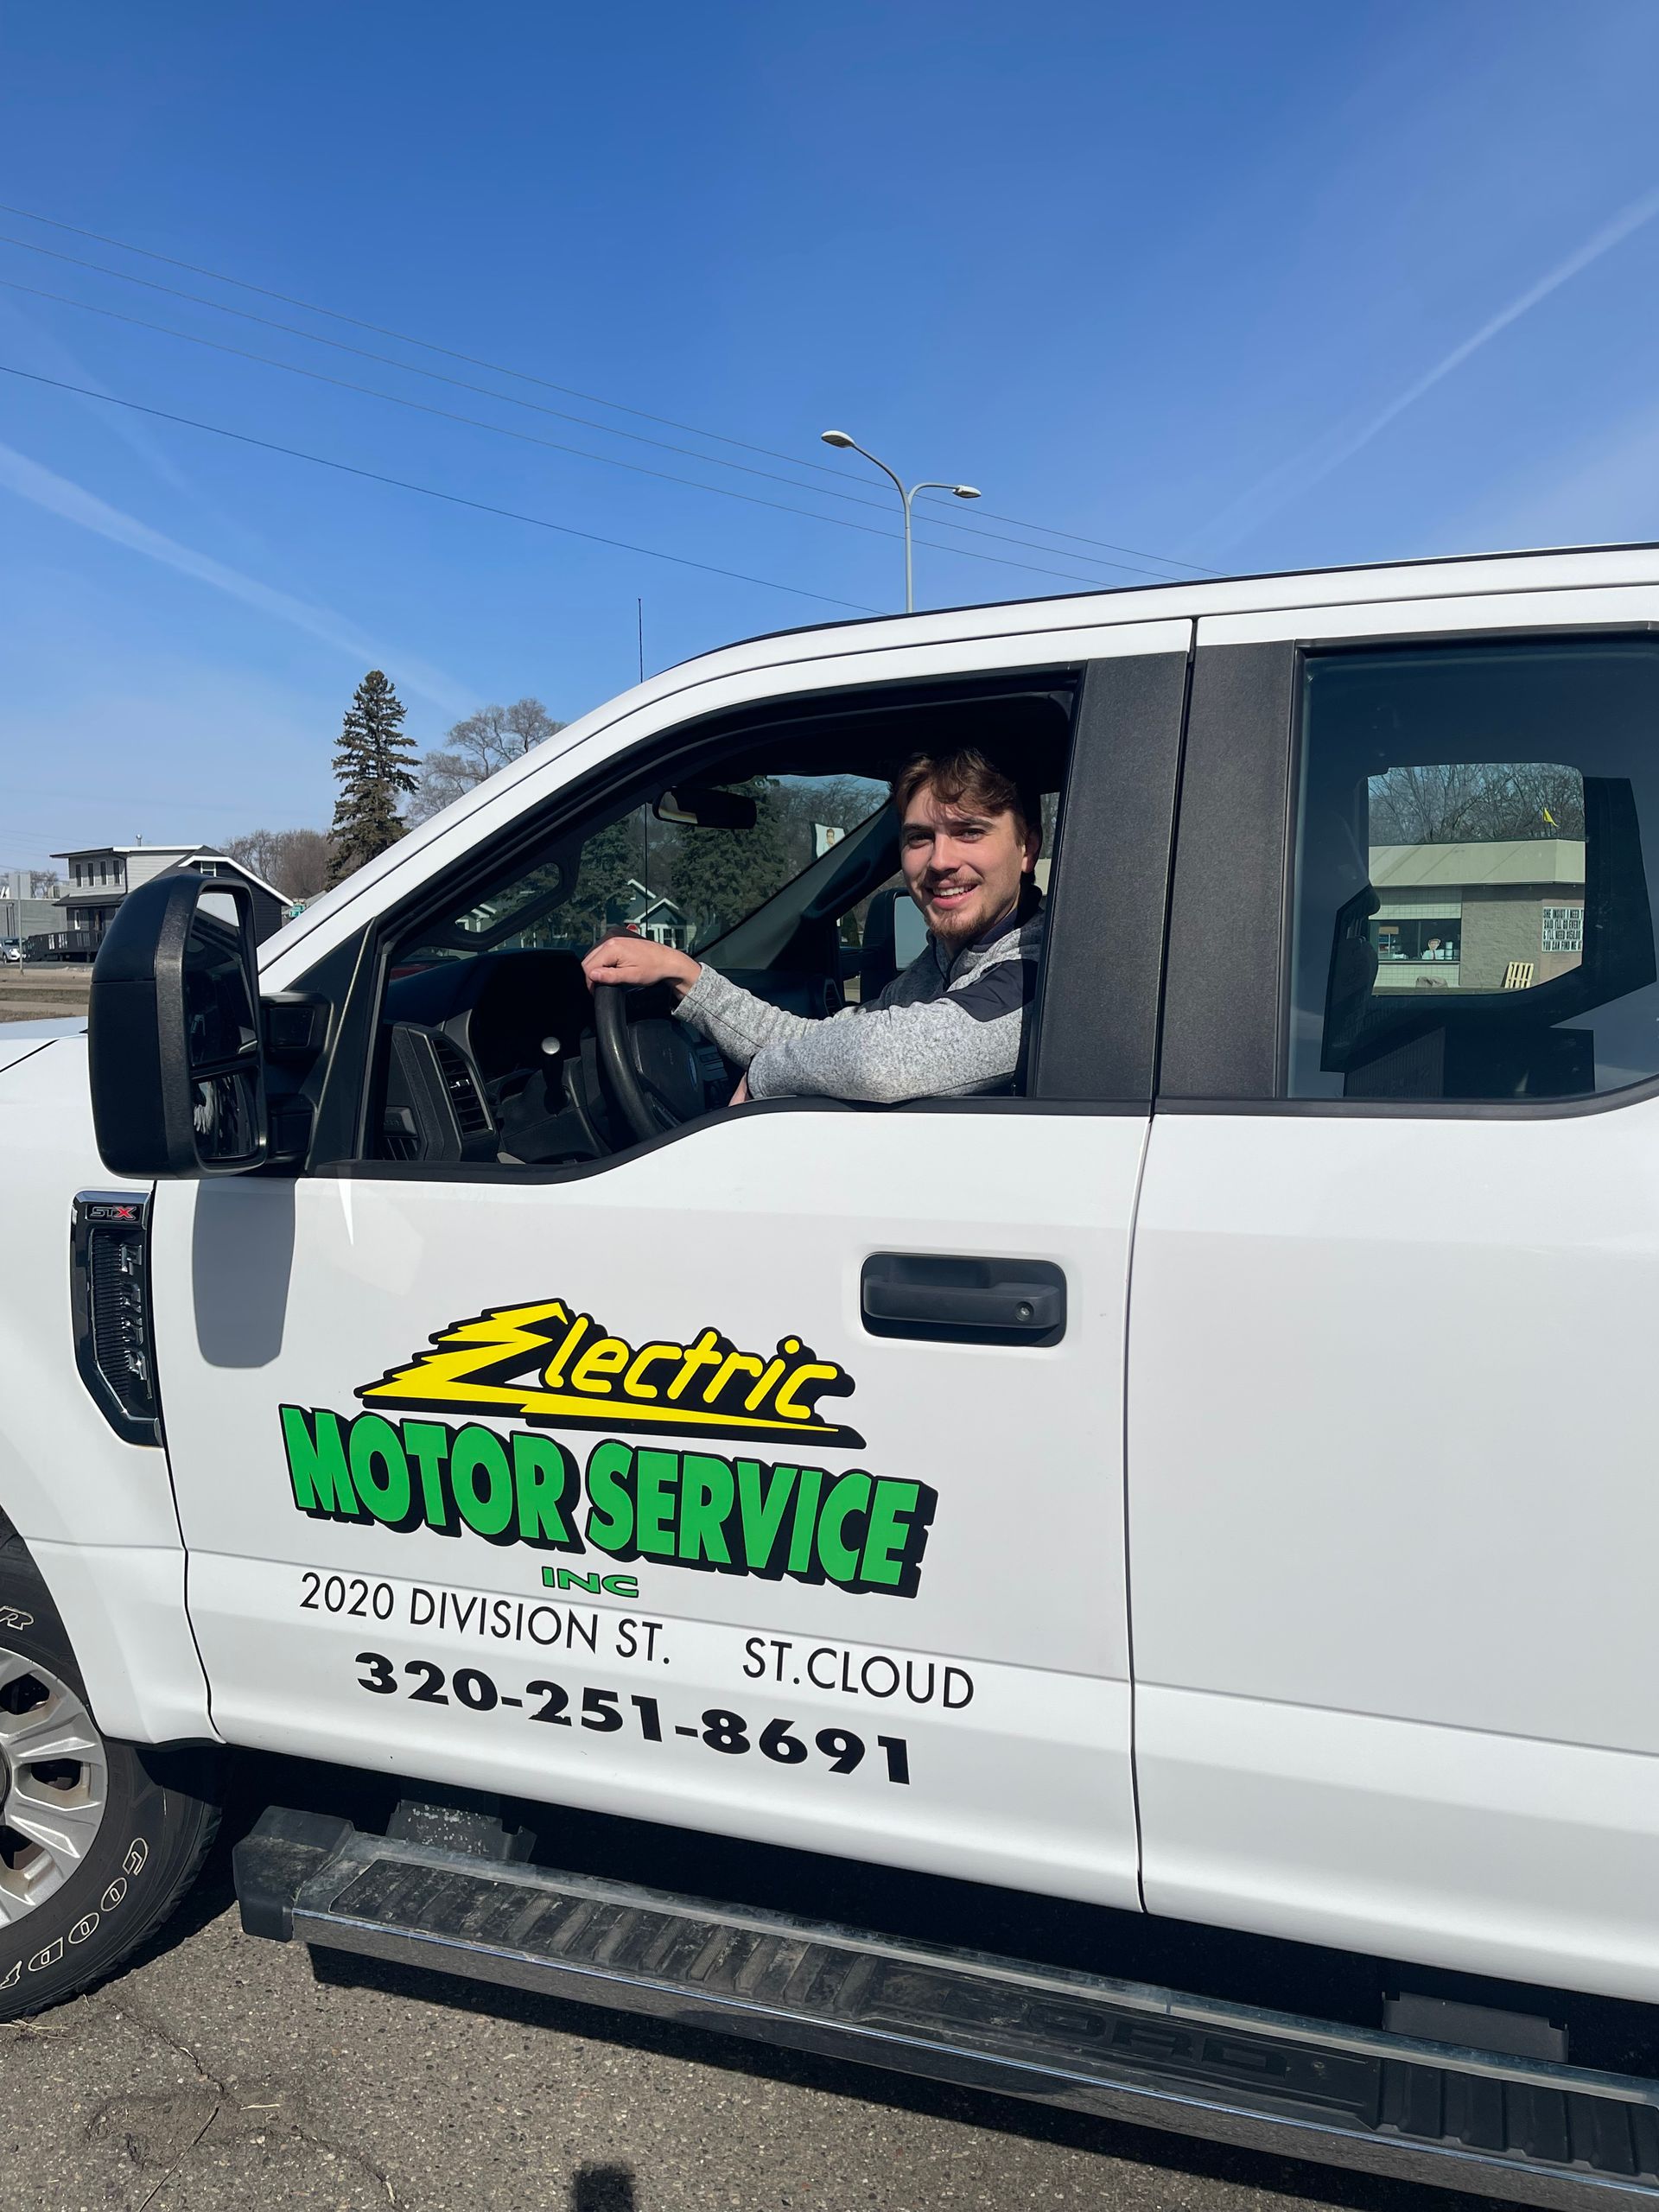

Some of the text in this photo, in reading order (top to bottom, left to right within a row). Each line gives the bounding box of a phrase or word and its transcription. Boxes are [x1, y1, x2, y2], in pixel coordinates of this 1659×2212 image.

[1544, 919, 1554, 929] SAID
[1563, 919, 1568, 929] GO
[1569, 920, 1581, 929] EVERY
[1570, 910, 1580, 918] NEED
[1552, 941, 1560, 950] CAN
[1561, 941, 1570, 950] FIND
[1555, 931, 1565, 939] NEED
[90, 1206, 137, 1220] STX
[353, 1299, 866, 1450] Electric
[279, 1403, 938, 1599] MOTOR SERVICE
[542, 1566, 639, 1599] INC
[300, 1571, 394, 1620] 2020
[410, 1587, 599, 1654] DIVISION
[615, 1618, 671, 1664] ST.
[355, 1651, 910, 1785] 320-251-8691
